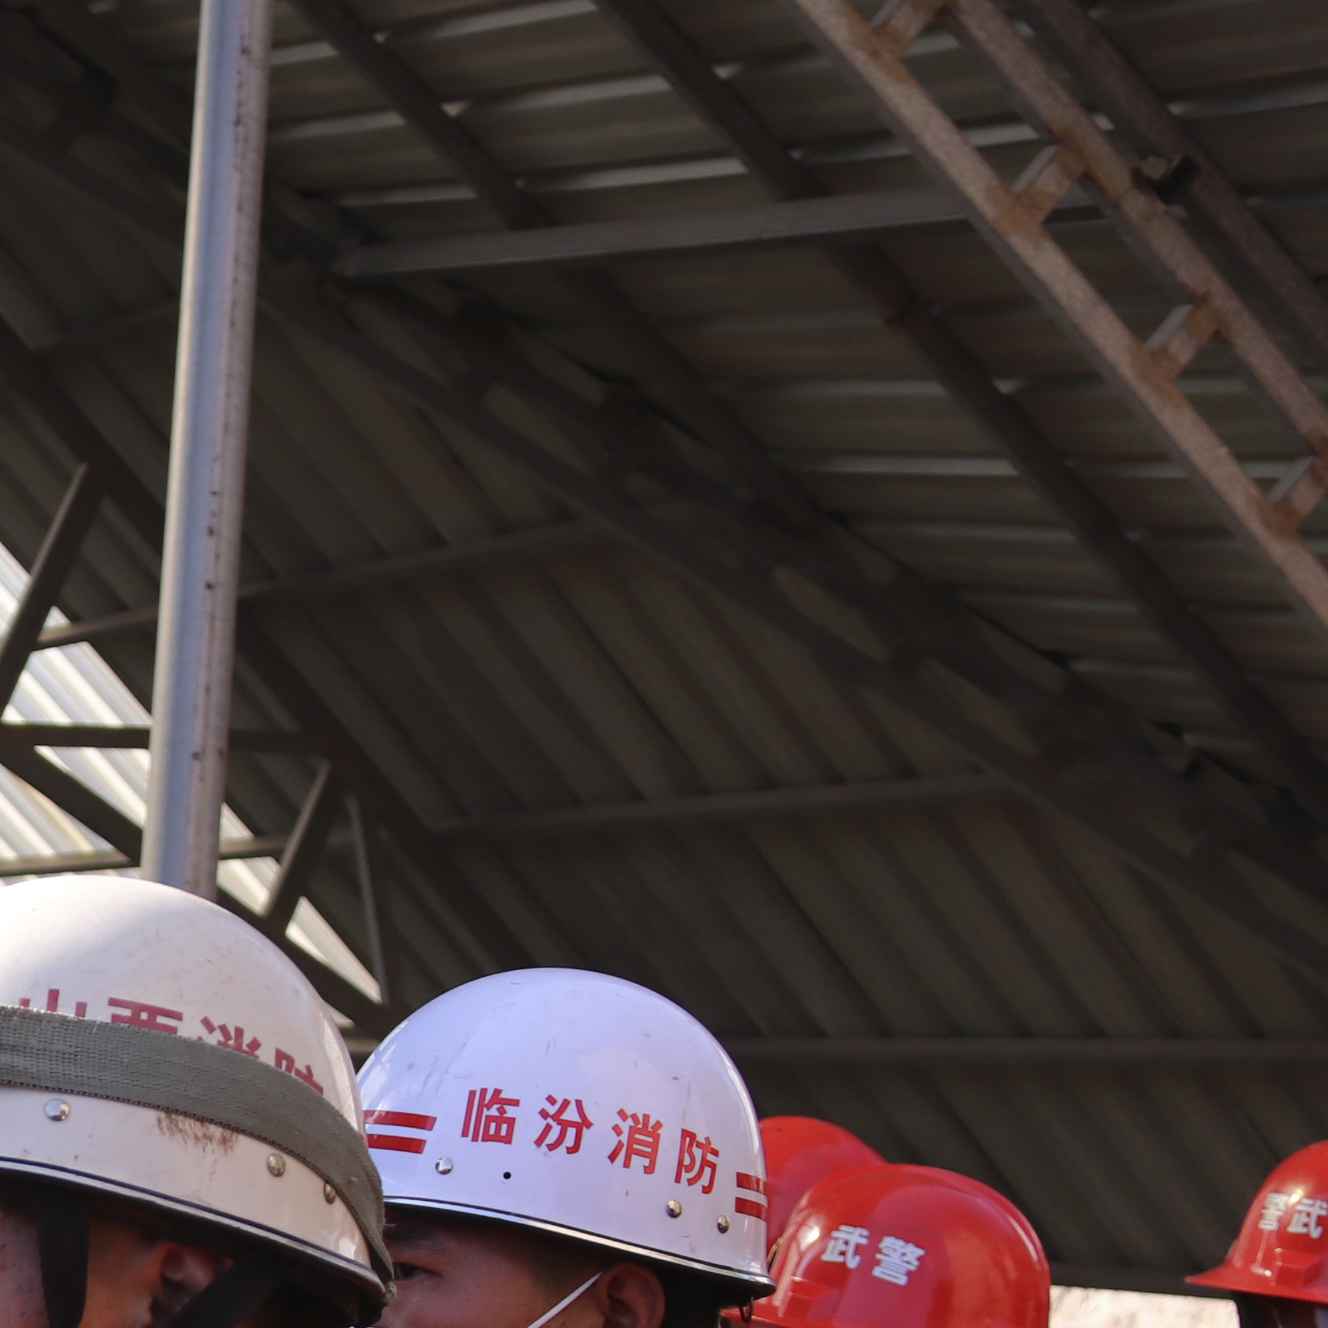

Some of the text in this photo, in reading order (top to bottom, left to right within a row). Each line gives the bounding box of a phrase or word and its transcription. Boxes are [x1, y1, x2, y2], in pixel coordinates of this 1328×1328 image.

[461, 1087, 720, 1195] 临汾消防
[820, 1224, 926, 1286] 武警
